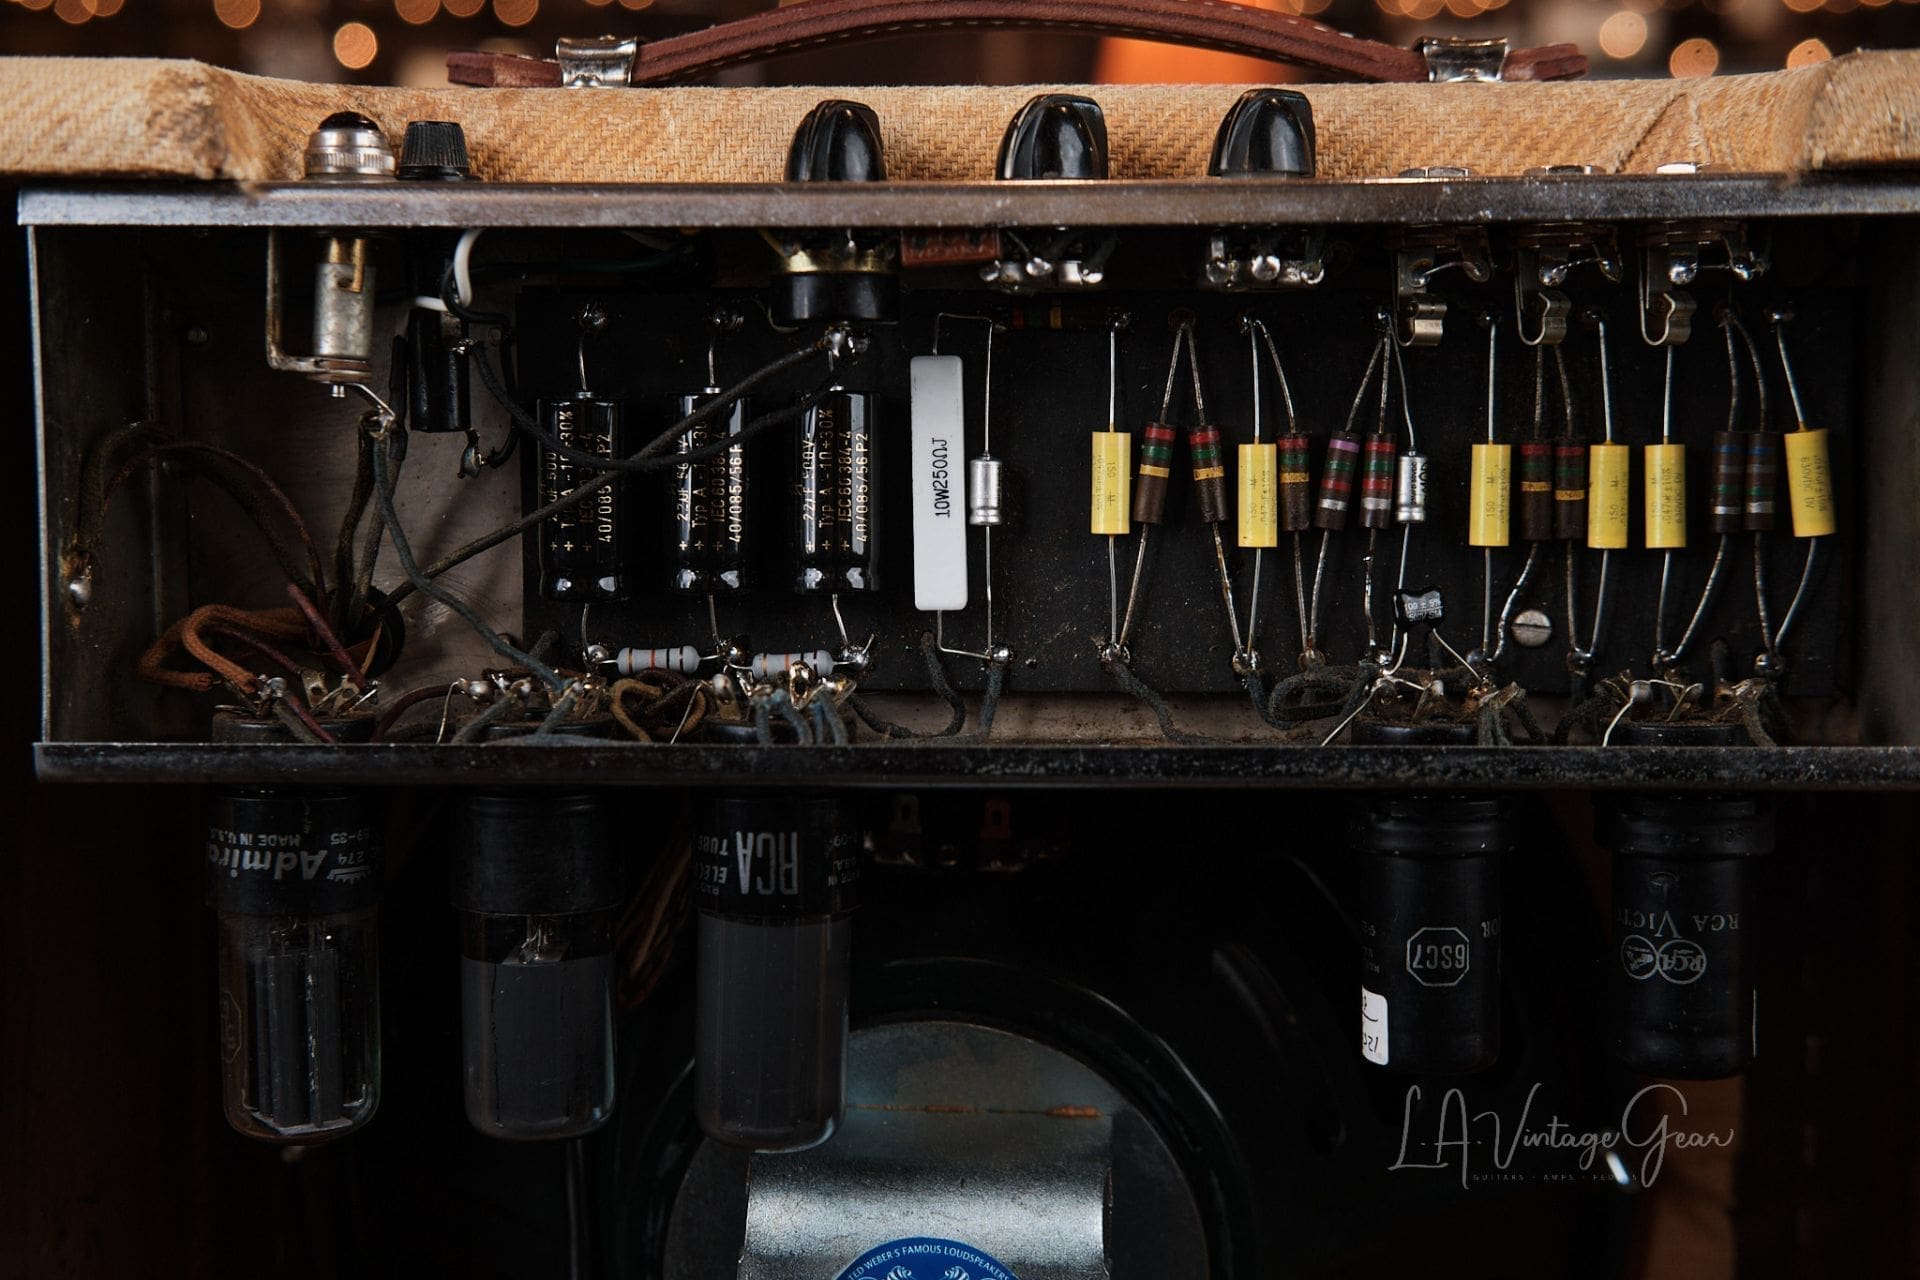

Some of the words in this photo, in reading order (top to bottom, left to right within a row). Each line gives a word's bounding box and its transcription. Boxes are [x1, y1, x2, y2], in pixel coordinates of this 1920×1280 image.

[597, 433, 612, 453] P2
[838, 431, 852, 474] 384-4
[856, 433, 869, 452] P2
[691, 487, 707, 498] A
[711, 477, 725, 496] 60
[818, 487, 834, 497] A
[838, 477, 852, 496] 60
[728, 457, 743, 542] 40/085/56
[856, 456, 869, 543] 40/085/56
[1486, 500, 1496, 518] 150
[692, 504, 708, 528] Typ
[711, 499, 726, 523] IEC
[818, 504, 835, 529] Typ
[838, 498, 853, 523] IEC
[239, 832, 254, 847] IN
[257, 833, 301, 847] MADE
[207, 842, 330, 882] Admira
[735, 830, 799, 896] RCA
[1690, 911, 1741, 933] RCA
[1411, 943, 1467, 970] 6SC7
[1659, 953, 1704, 973] RCA
[902, 1244, 942, 1256] FAMOUS
